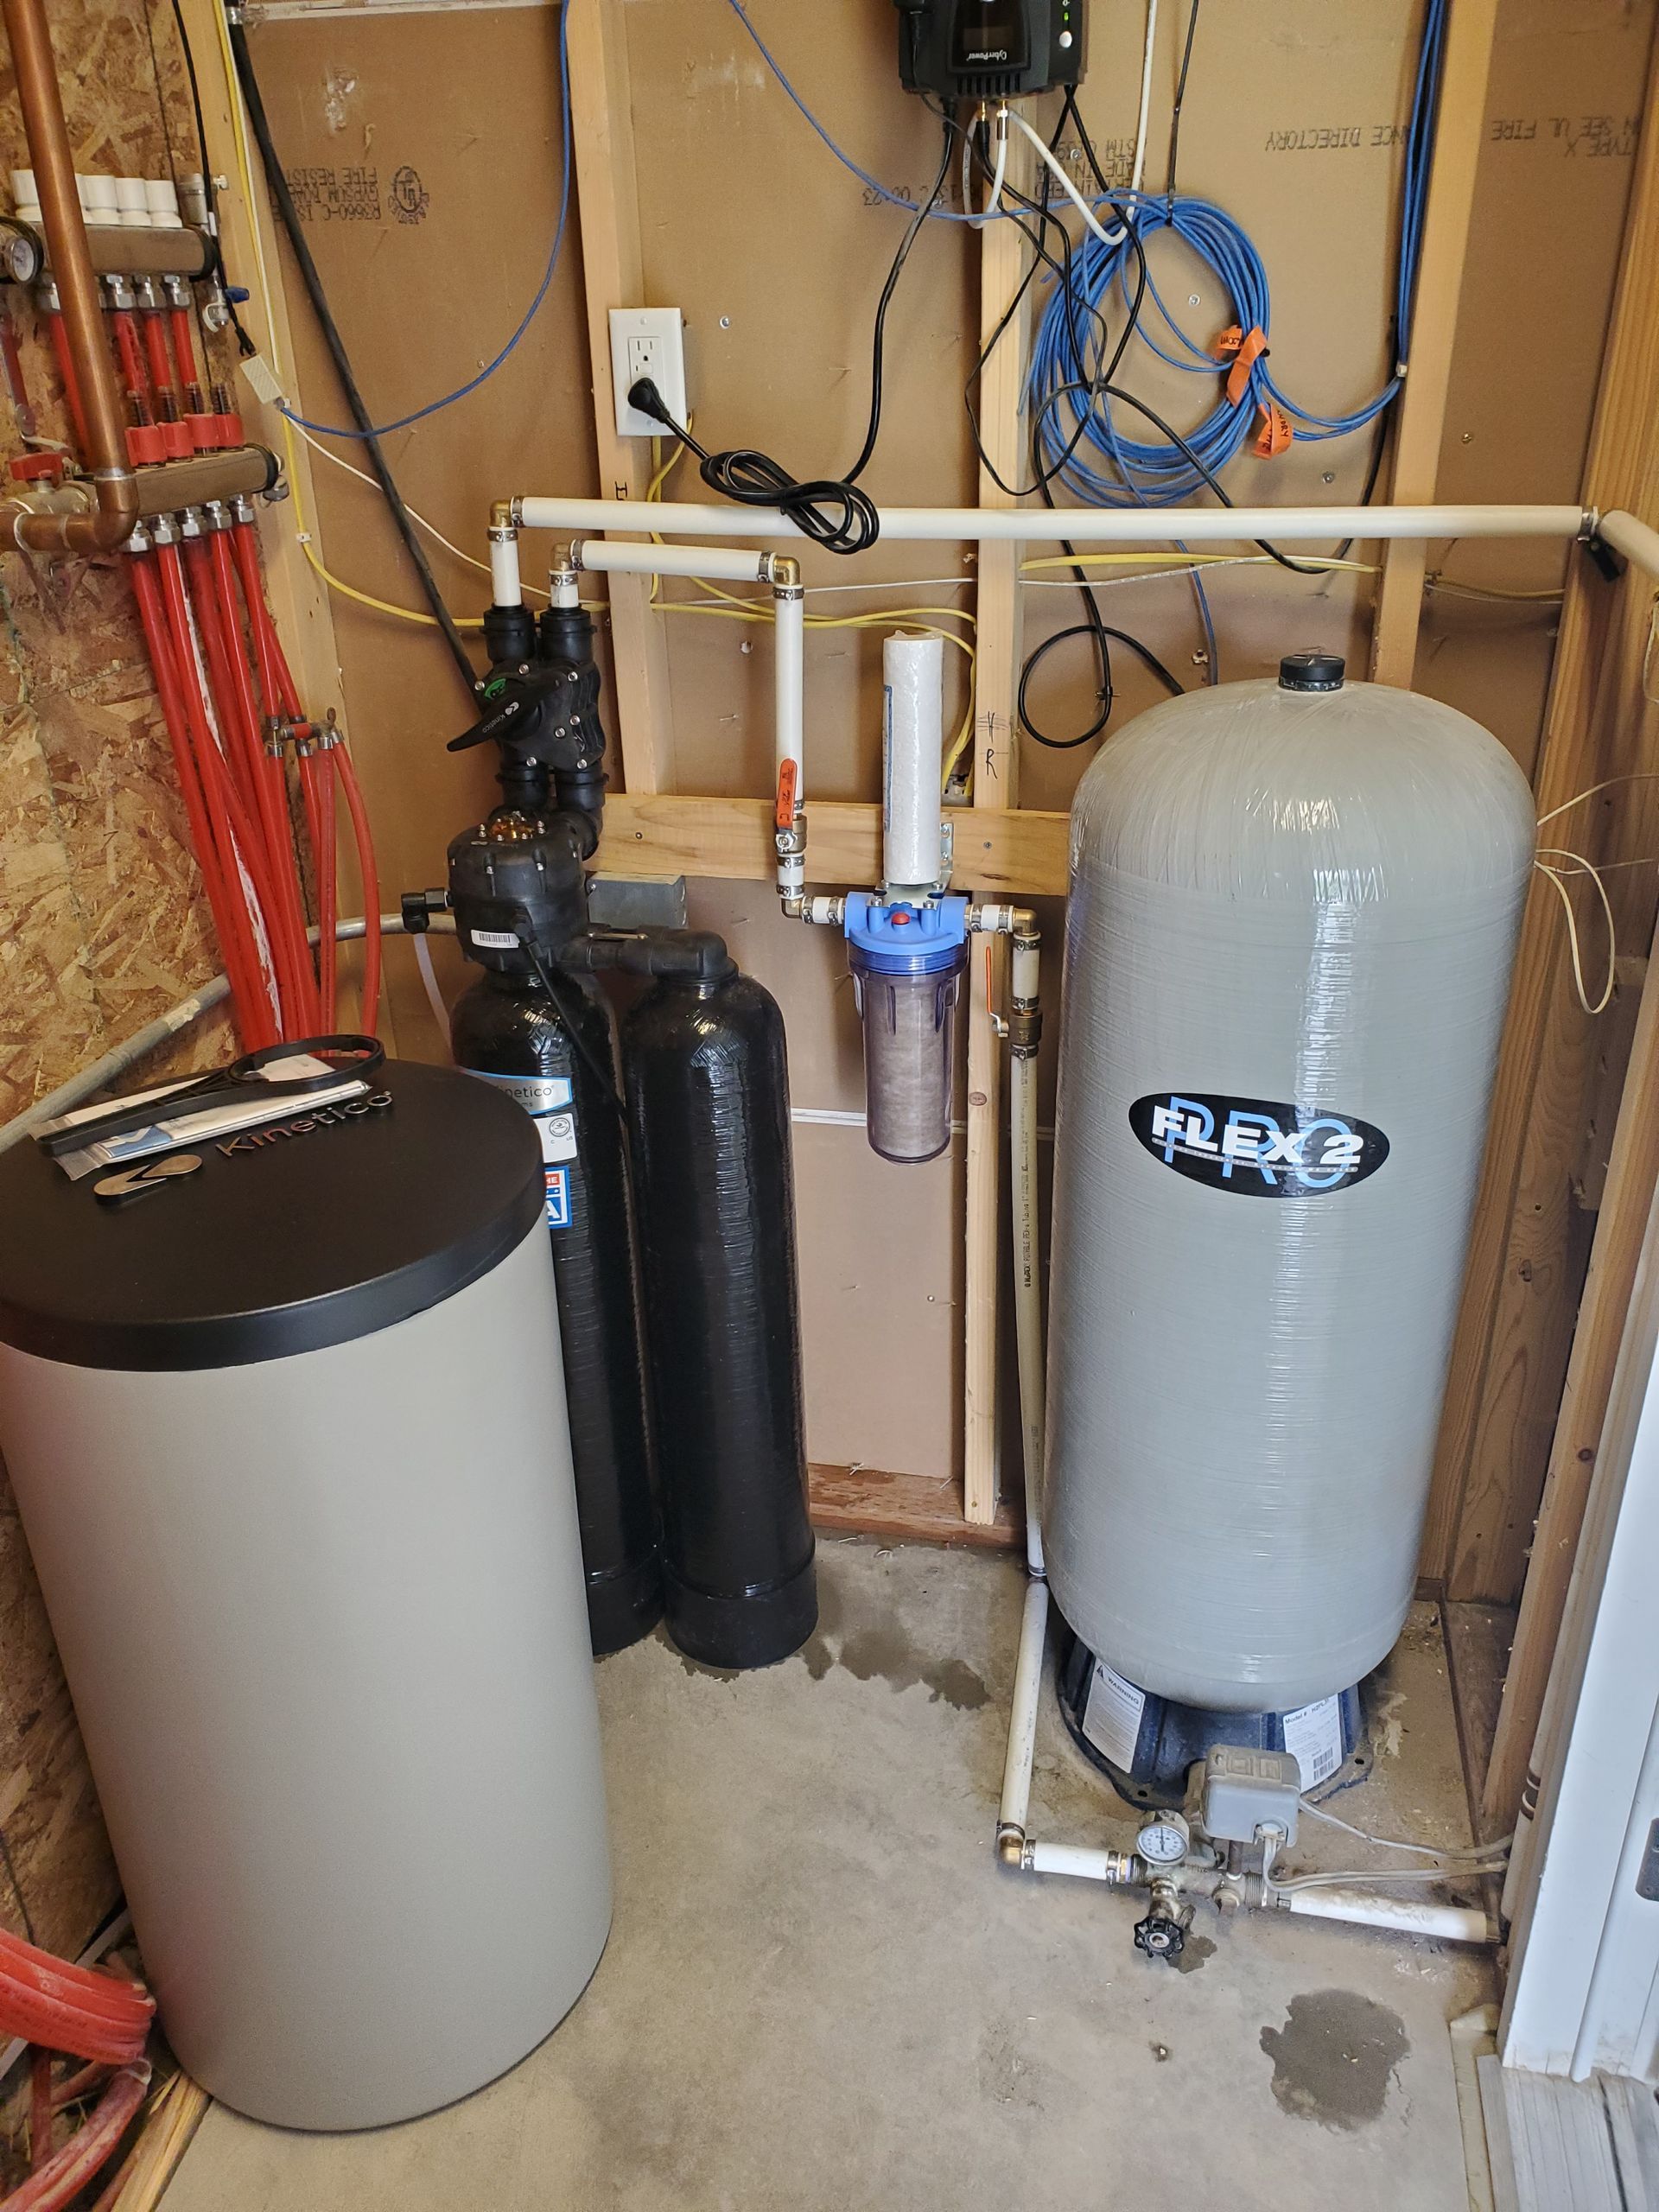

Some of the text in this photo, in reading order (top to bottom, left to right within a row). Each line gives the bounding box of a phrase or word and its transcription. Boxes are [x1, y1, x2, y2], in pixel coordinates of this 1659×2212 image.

[967, 49, 1007, 61] CyberPower
[1265, 127, 1362, 151] DIRECTORY
[1491, 119, 1537, 141] FIRE
[1564, 137, 1633, 158] TYPE X
[342, 167, 378, 185] FIRE
[327, 185, 379, 204] GYPSUM
[322, 203, 382, 222] R3660-C
[984, 747, 1000, 780] R
[214, 1094, 394, 1158] Kinetico
[1151, 1104, 1306, 1164] FLEX
[1319, 1134, 1365, 1166] 2
[1107, 1675, 1140, 1706] WARNING
[1285, 1713, 1303, 1725] Model
